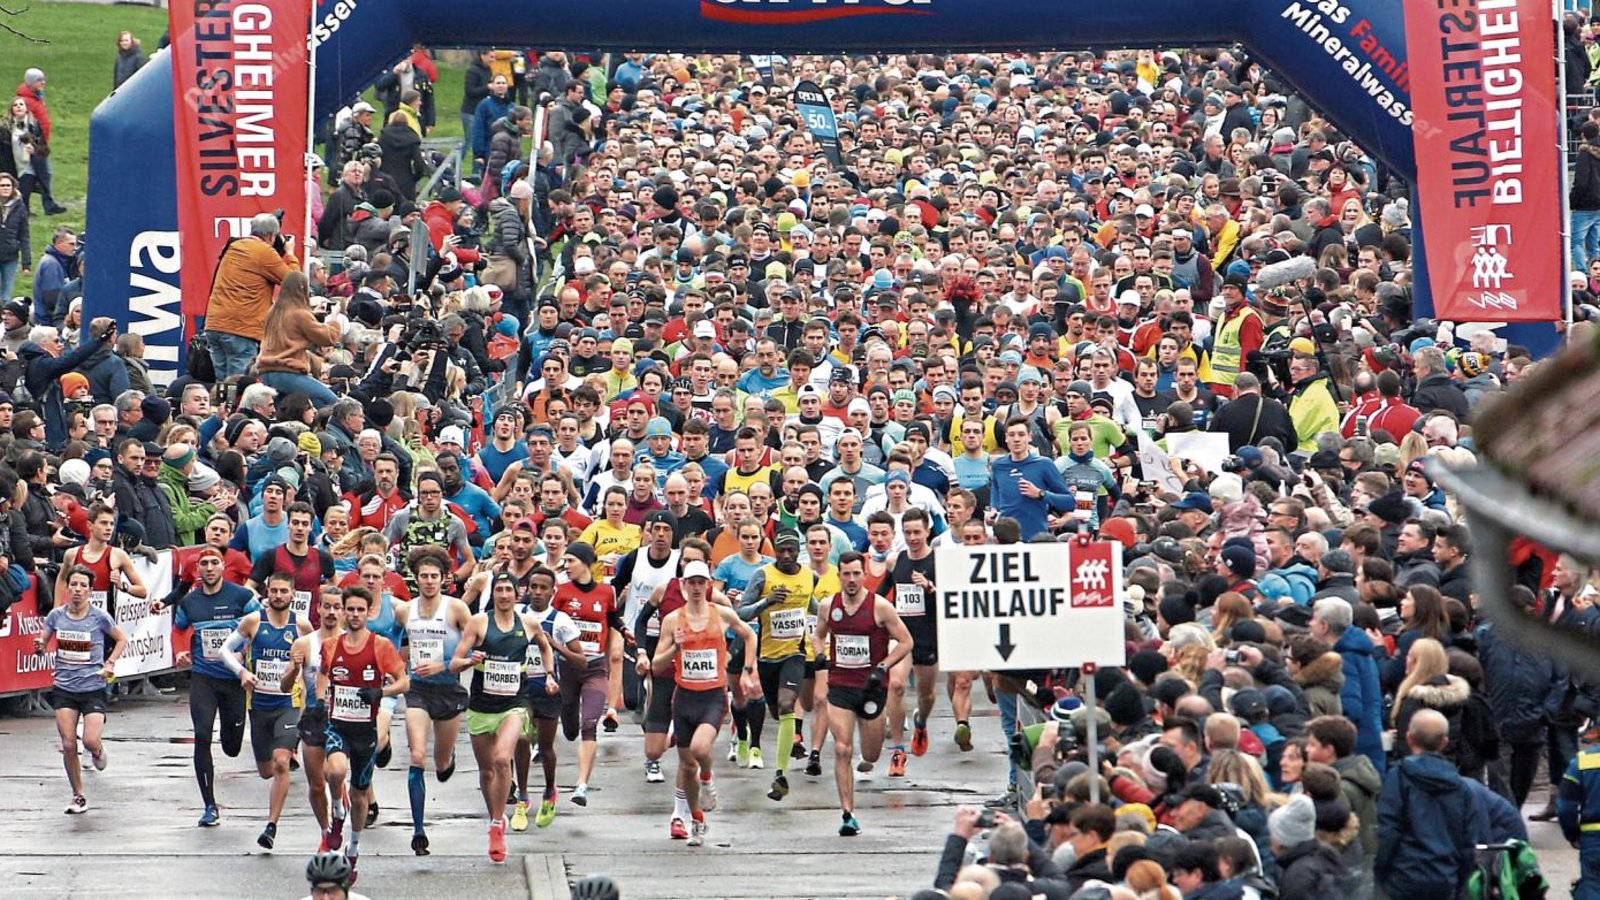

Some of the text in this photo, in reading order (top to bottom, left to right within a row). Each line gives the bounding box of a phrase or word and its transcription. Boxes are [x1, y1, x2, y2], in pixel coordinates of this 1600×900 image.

[1305, 0, 1352, 24] as
[808, 113, 826, 129] 50
[969, 552, 1040, 584] ZIEL
[291, 600, 306, 611] 106
[903, 593, 921, 605] 103
[944, 587, 1065, 619] EINLAUF
[772, 618, 804, 631] YASSIN
[836, 646, 869, 657] FLORIAN
[683, 659, 715, 672] KARL
[485, 671, 519, 684] THORBEN
